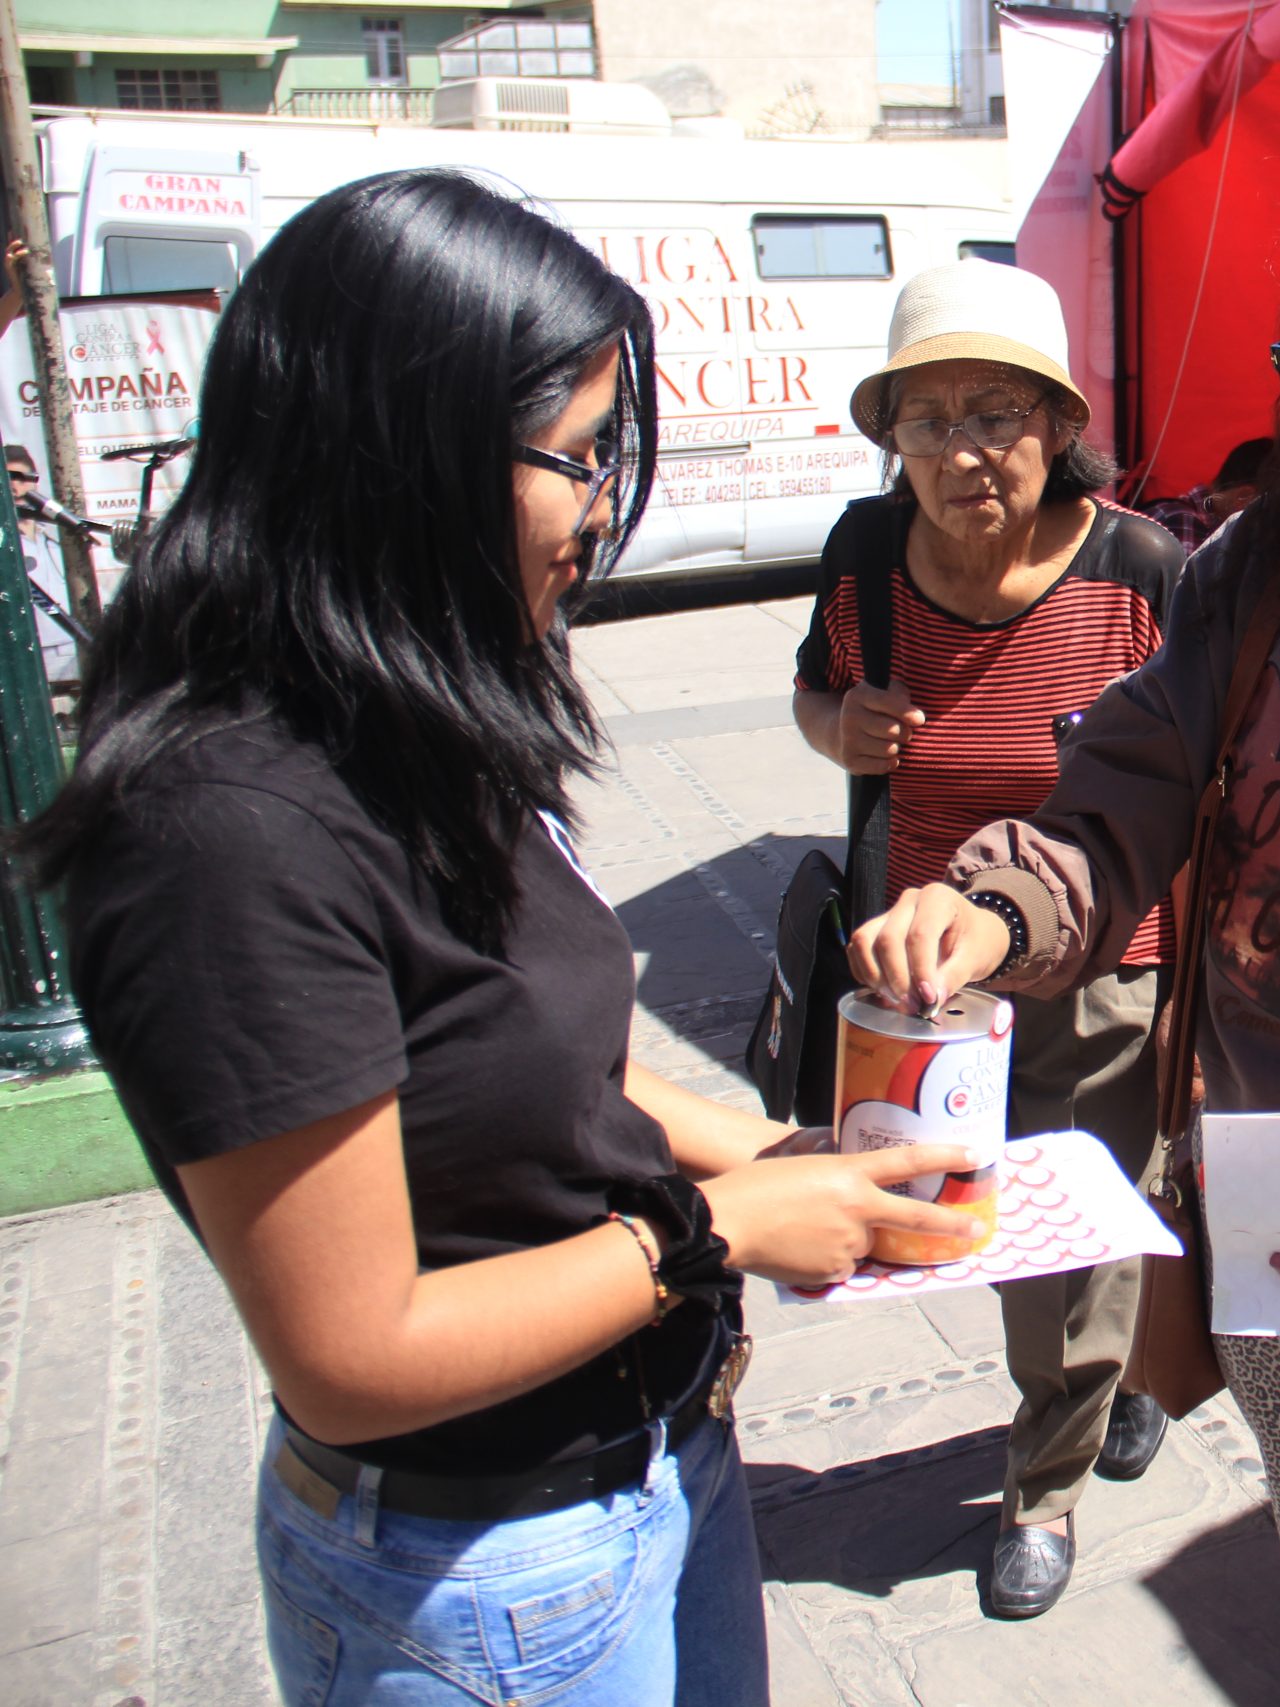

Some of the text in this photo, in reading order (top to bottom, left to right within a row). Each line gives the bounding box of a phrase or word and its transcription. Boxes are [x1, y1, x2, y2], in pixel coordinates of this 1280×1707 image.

[144, 175, 220, 193] GRAN
[119, 194, 246, 215] CAMPAÑA
[19, 367, 187, 405] CMPAÑA
[655, 357, 813, 409] NCER
[111, 401, 129, 412] DE
[657, 417, 784, 446] AREQUIPA
[717, 457, 774, 477] THOMAS
[777, 455, 803, 472] E-10
[806, 450, 868, 470] AREQUIPA
